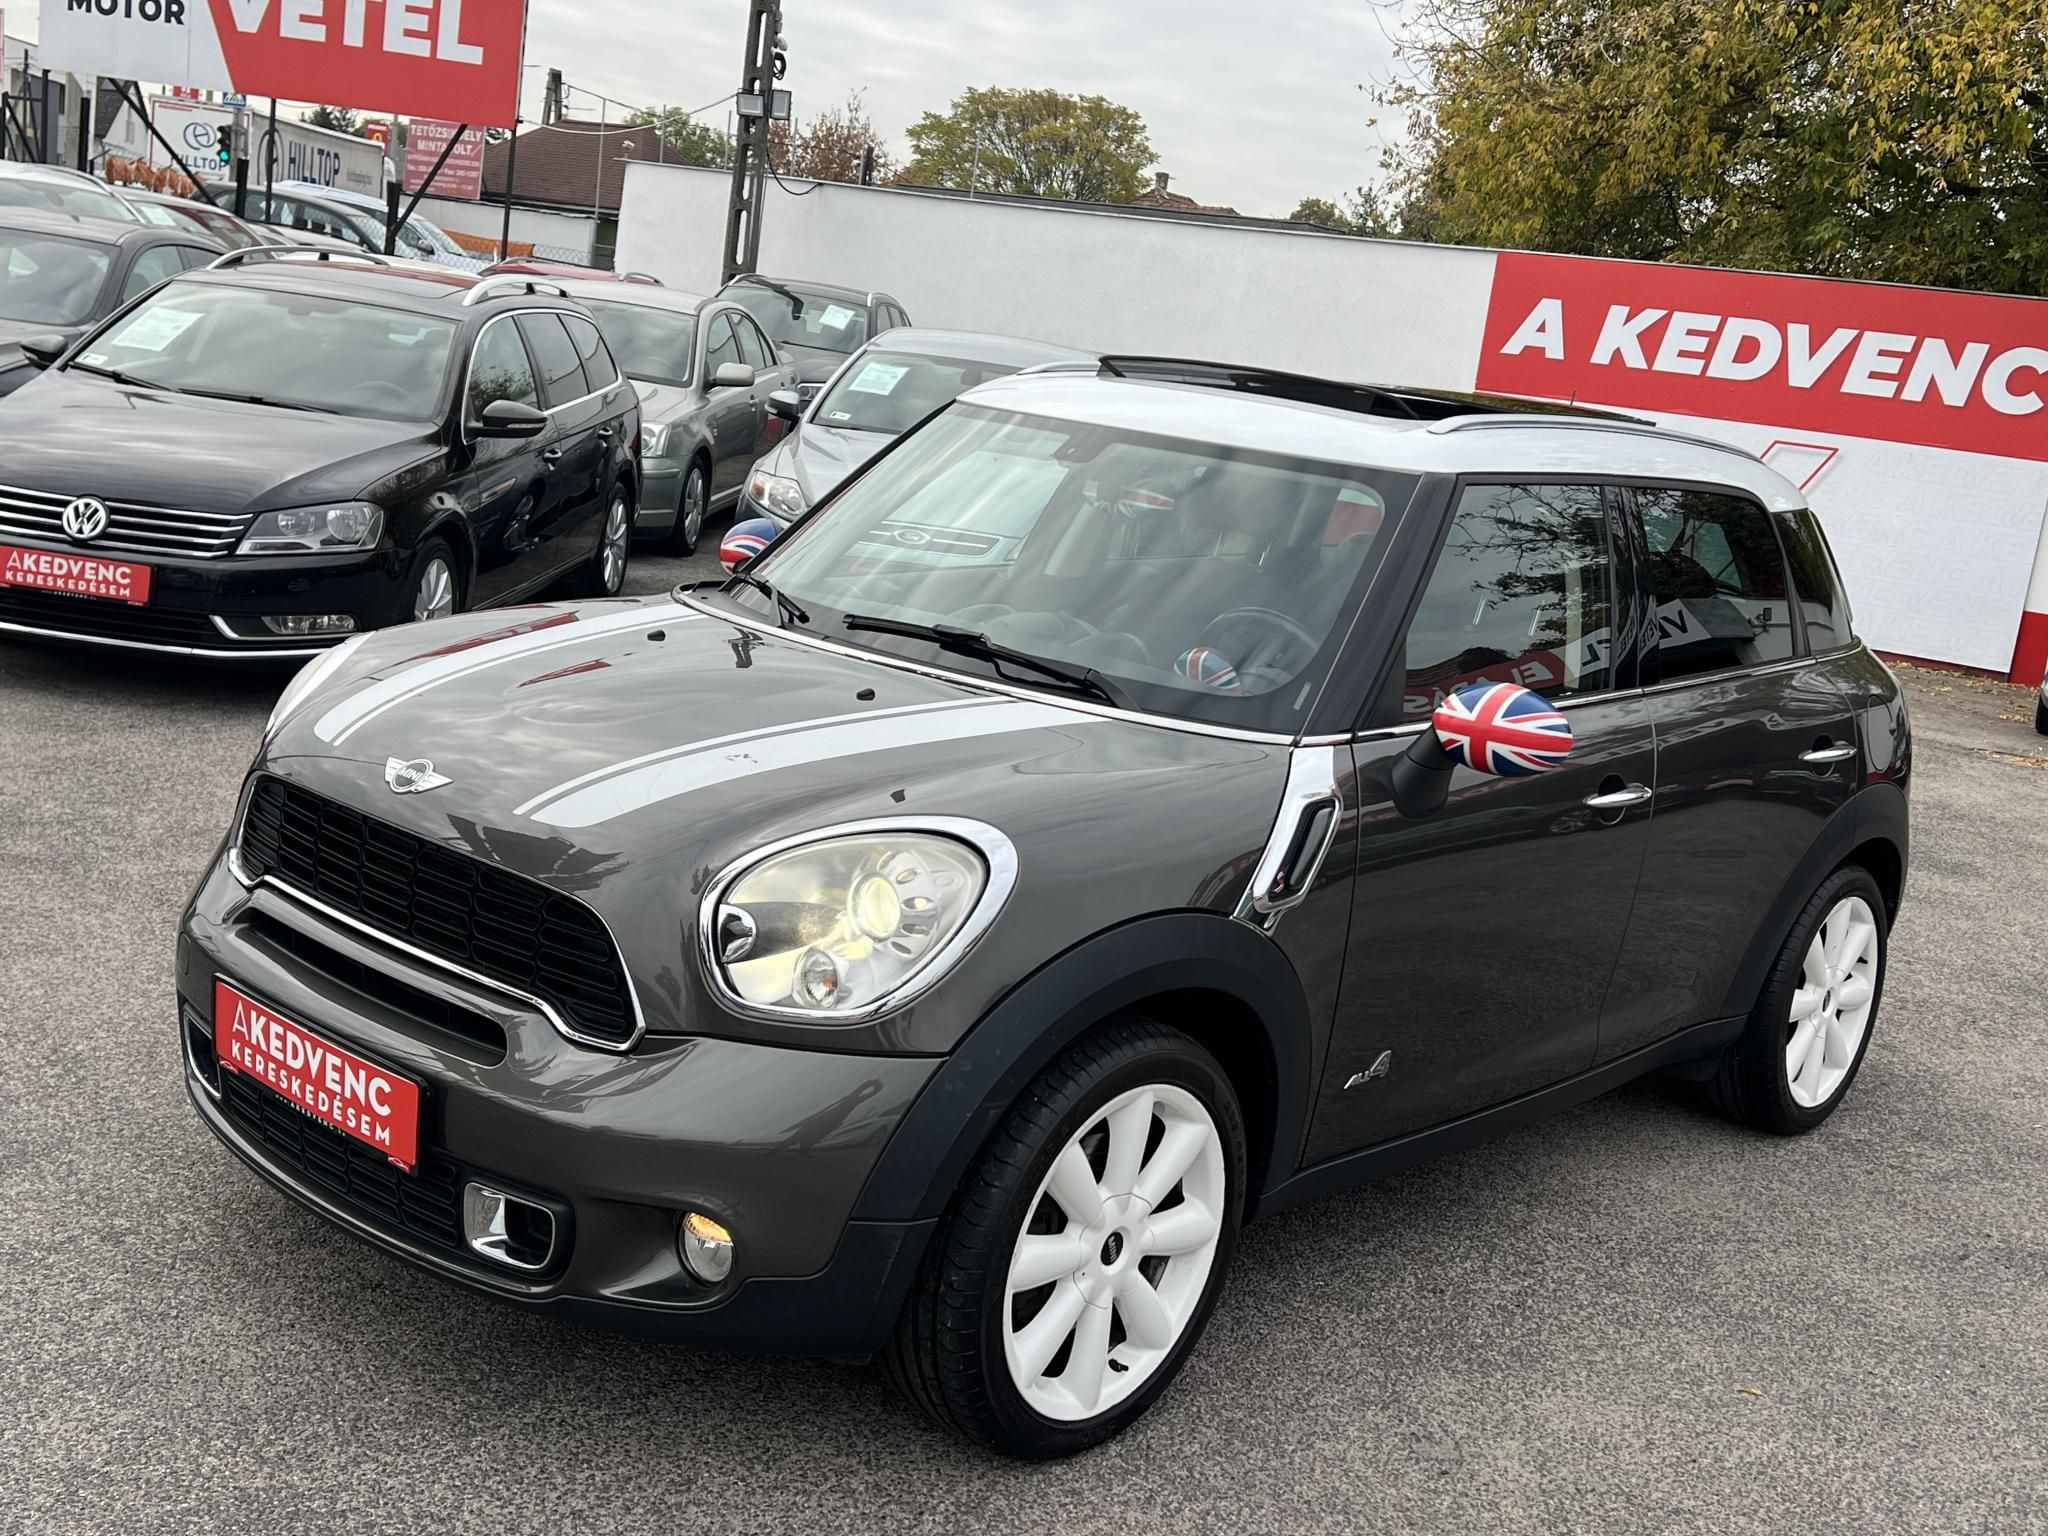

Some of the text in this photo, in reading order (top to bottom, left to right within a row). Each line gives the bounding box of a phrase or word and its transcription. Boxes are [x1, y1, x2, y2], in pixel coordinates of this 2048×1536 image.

[67, 0, 185, 25] MOTOR
[288, 141, 341, 188] HILLTOP
[1500, 298, 2048, 415] A KEDVENC
[5, 570, 130, 597] KERESKEDÉSEM
[397, 766, 425, 783] MINI
[231, 1039, 391, 1146] KERESKEDÉSEM
